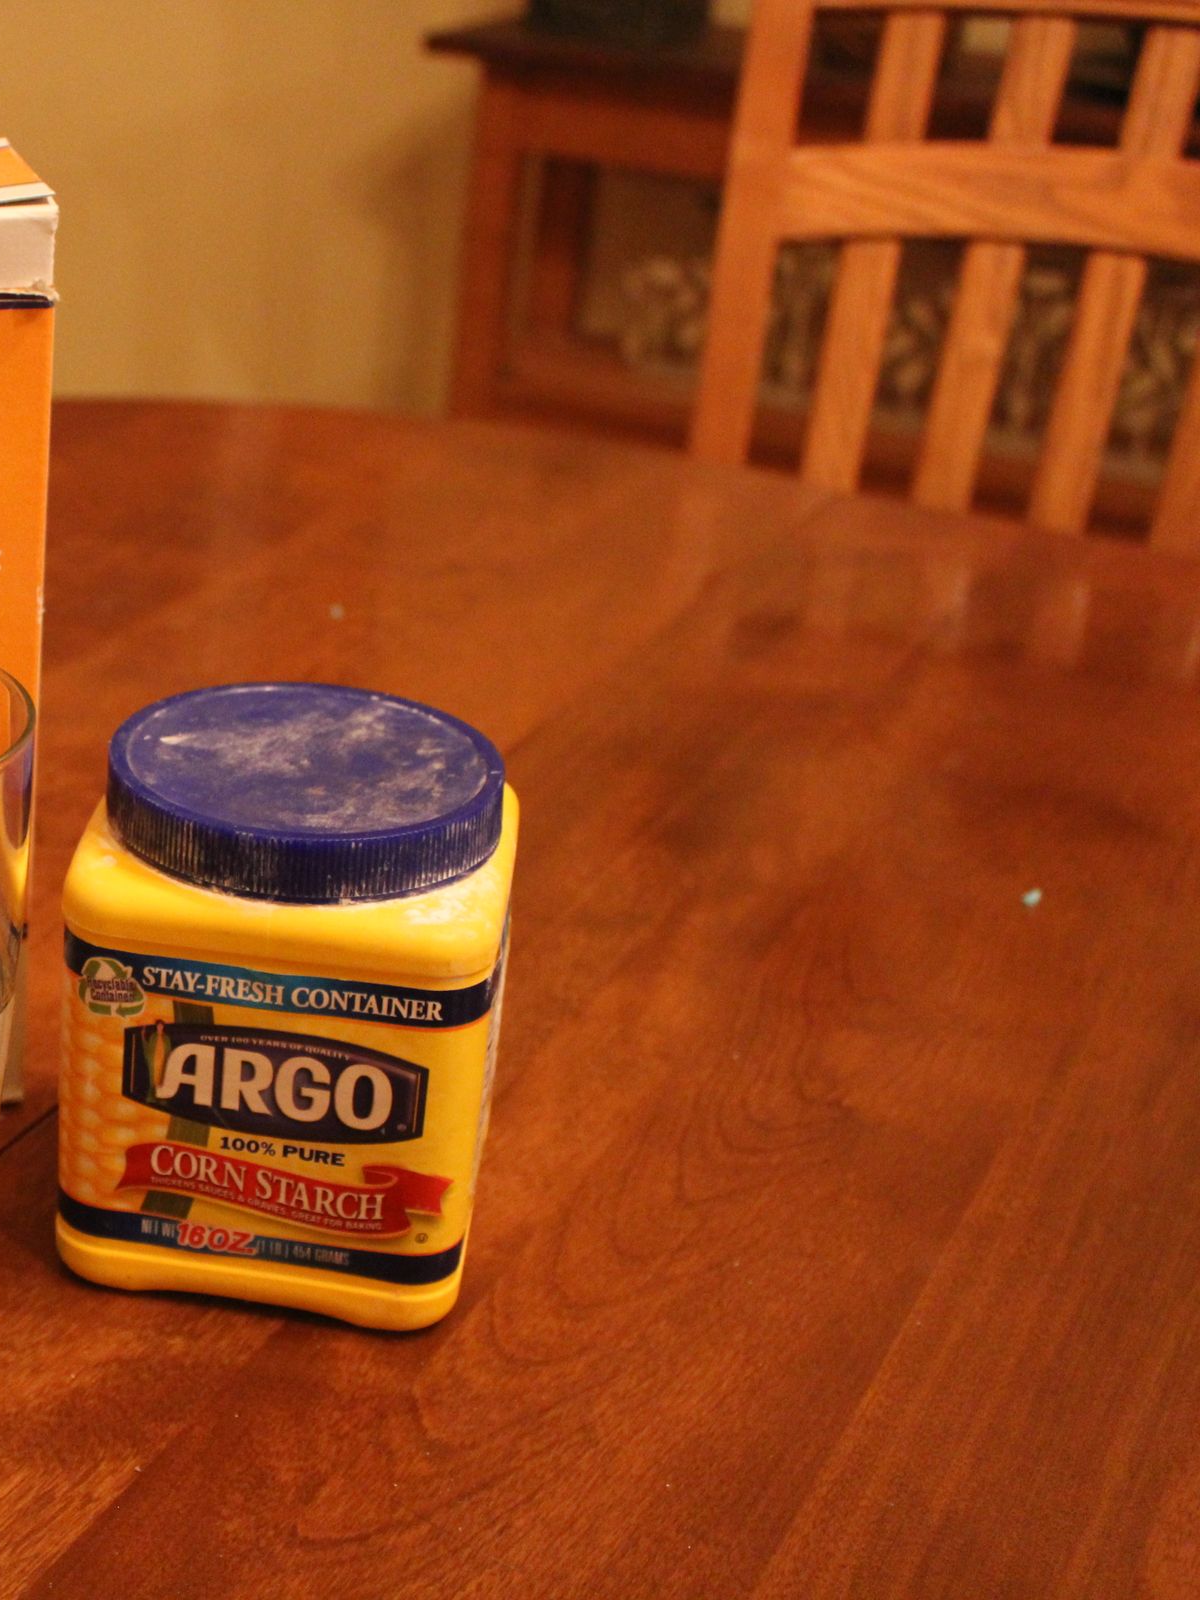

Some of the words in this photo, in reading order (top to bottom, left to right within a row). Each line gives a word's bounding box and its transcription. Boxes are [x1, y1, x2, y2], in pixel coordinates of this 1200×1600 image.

[142, 966, 284, 1006] STAY-FRESH
[291, 987, 443, 1021] CONTAINER
[200, 1034, 228, 1043] OVER
[252, 1039, 287, 1049] YEARS
[305, 1045, 350, 1061] QUALITY
[155, 1043, 393, 1131] ARGO
[220, 1136, 276, 1157] 100%
[282, 1145, 346, 1167] PURE
[150, 1145, 247, 1193] CORN
[255, 1169, 385, 1221] STARCH
[291, 1210, 321, 1224] GREAT
[324, 1217, 344, 1229] FOR
